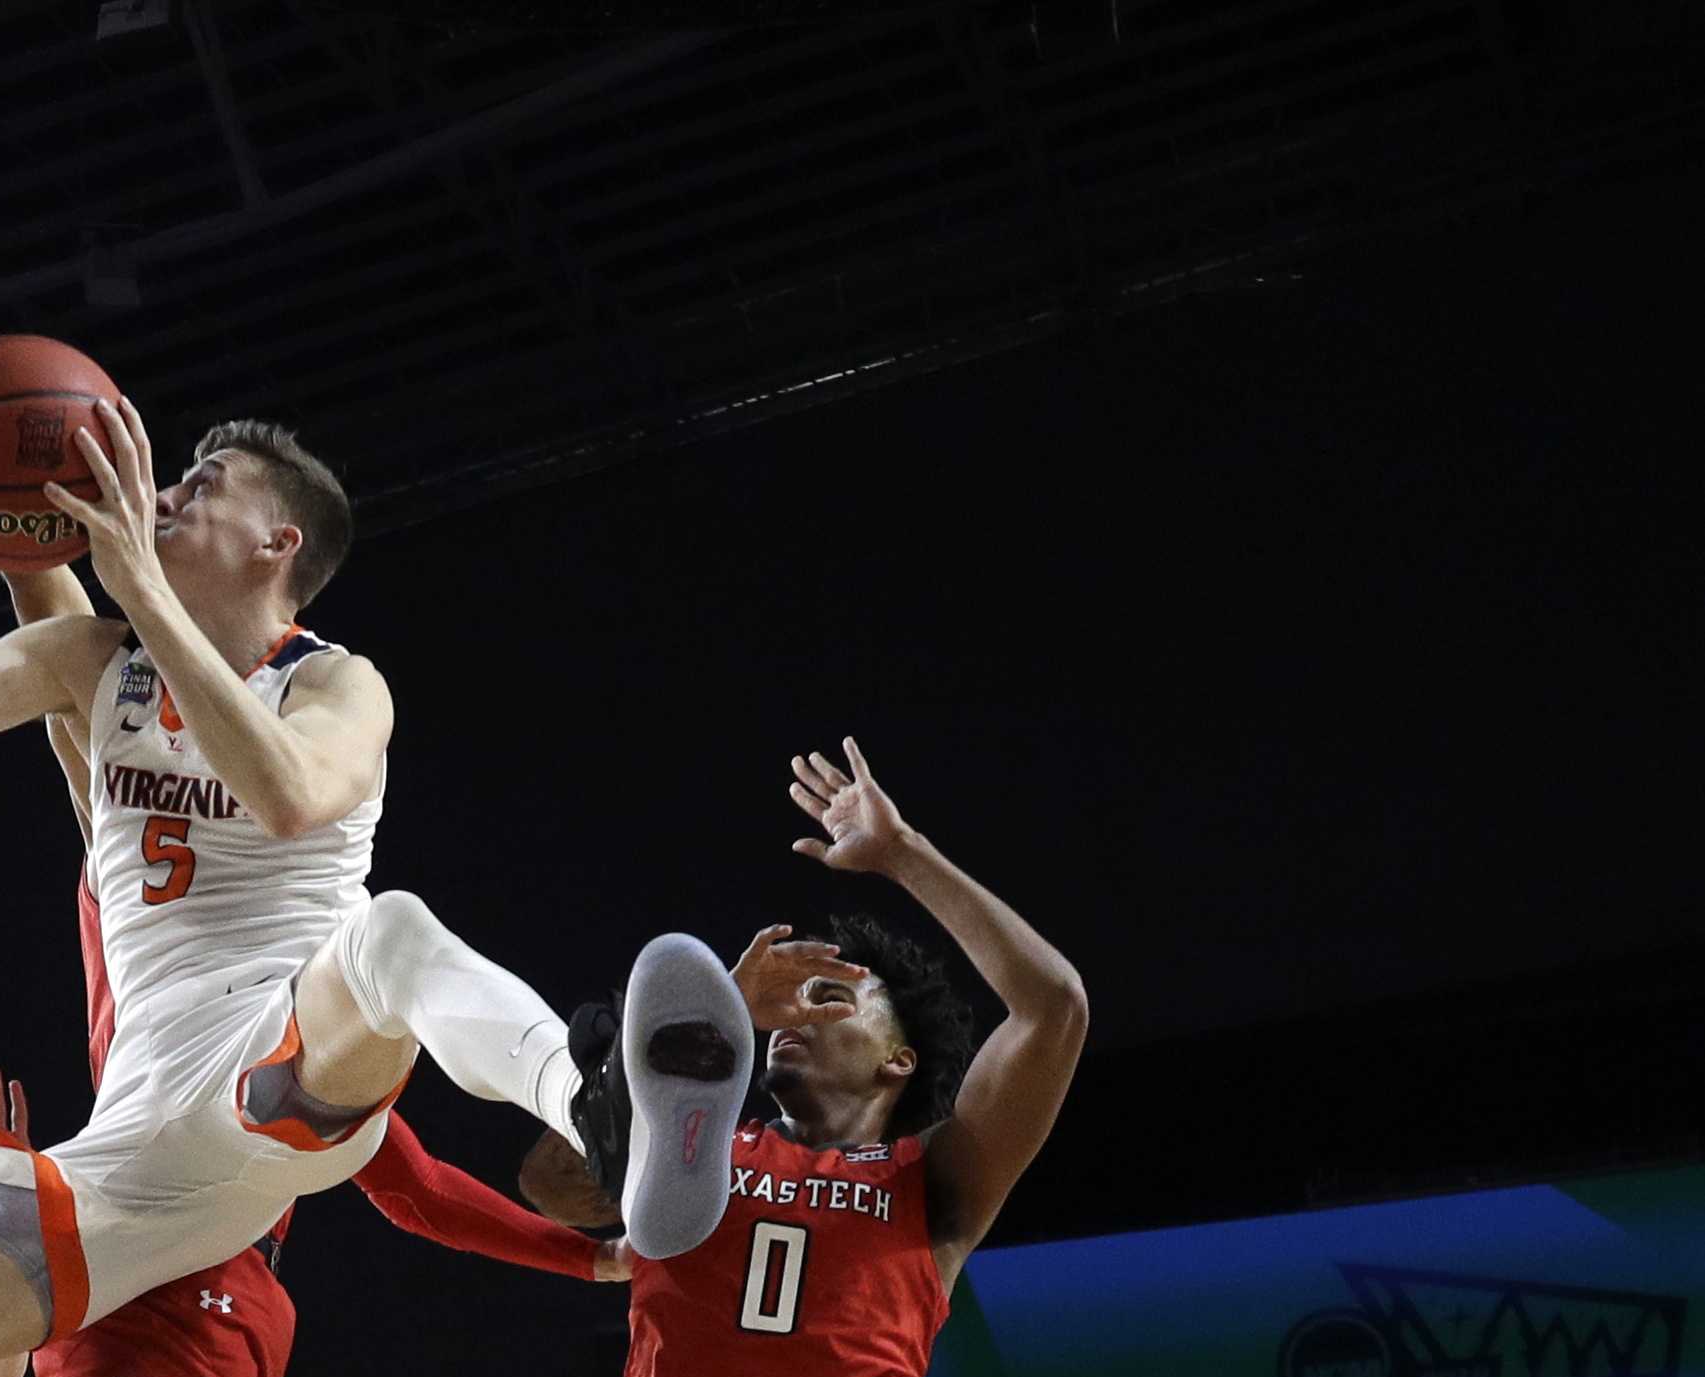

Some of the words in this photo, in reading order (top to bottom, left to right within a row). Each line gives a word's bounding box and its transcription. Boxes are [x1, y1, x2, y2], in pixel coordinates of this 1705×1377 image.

[142, 815, 196, 906] 5
[805, 1178, 893, 1222] TECH
[740, 1221, 808, 1334] 0
